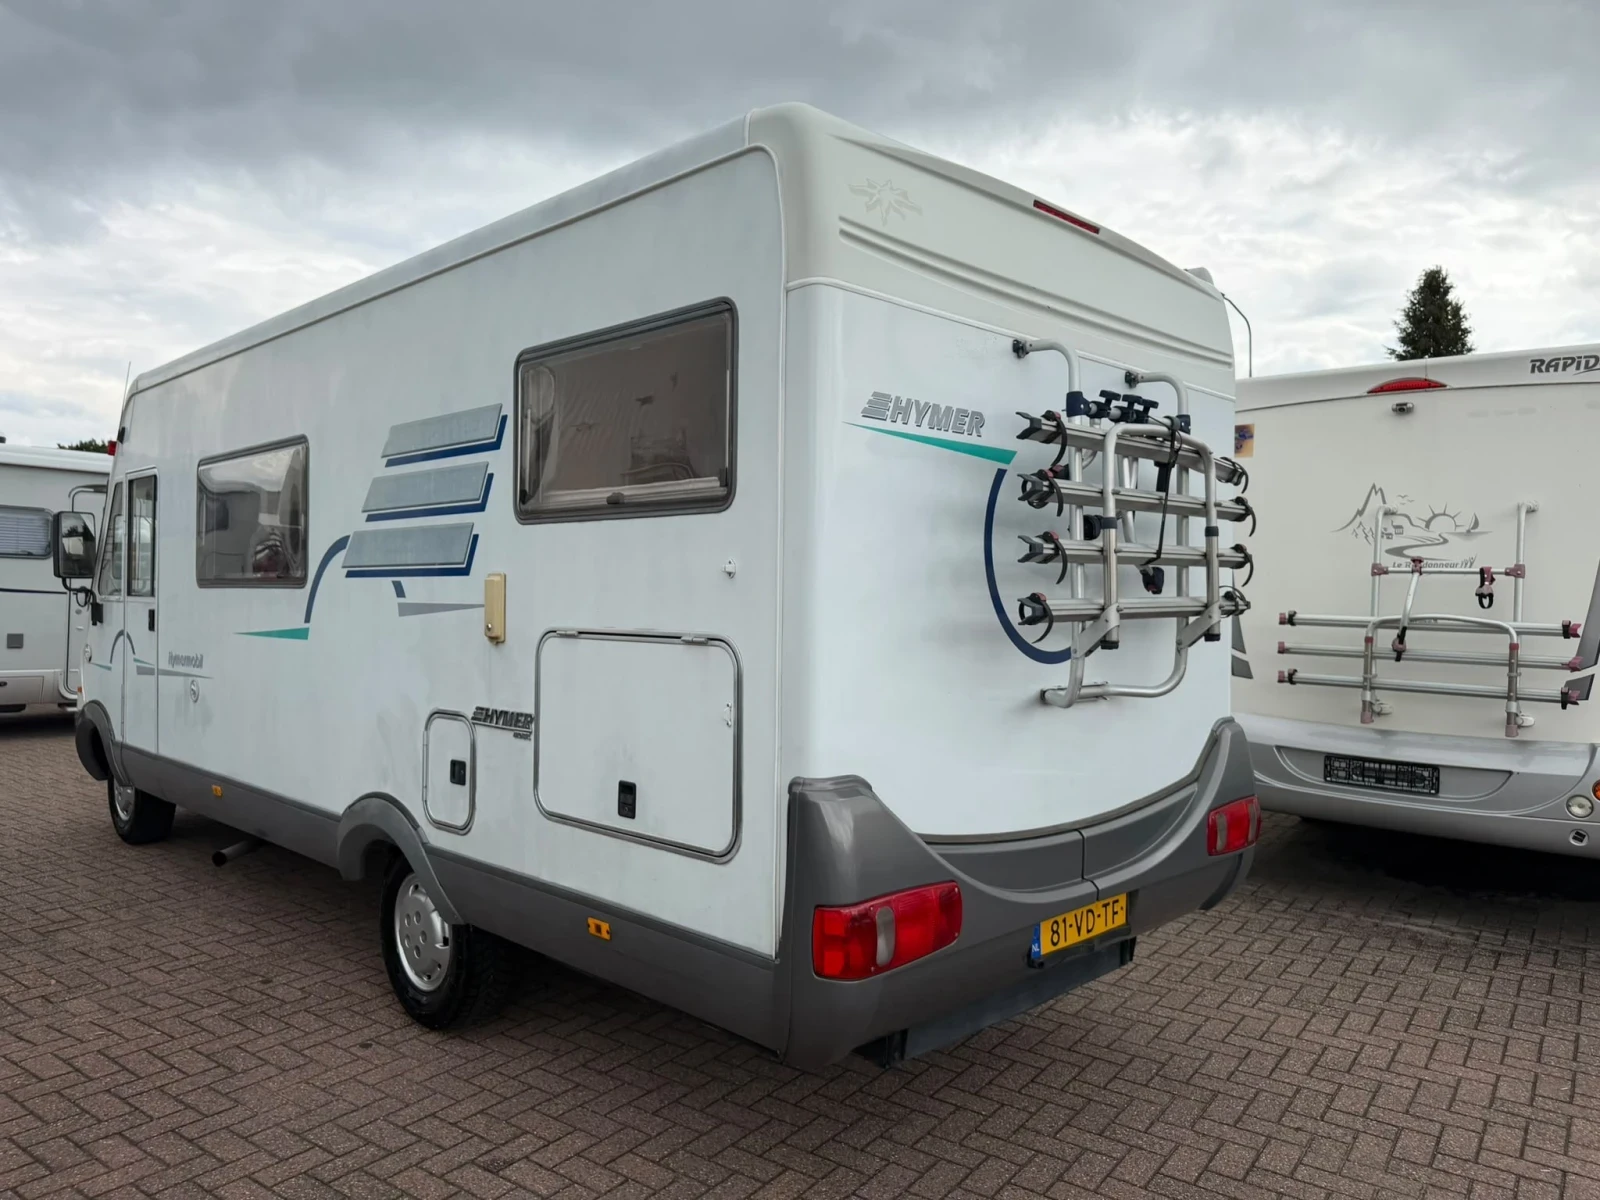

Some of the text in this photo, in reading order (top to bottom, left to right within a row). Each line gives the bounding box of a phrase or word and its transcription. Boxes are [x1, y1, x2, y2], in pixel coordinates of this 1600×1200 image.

[889, 395, 986, 437] HYMER
[483, 707, 535, 730] HYMER
[1050, 899, 1119, 947] 81-VD-TF
